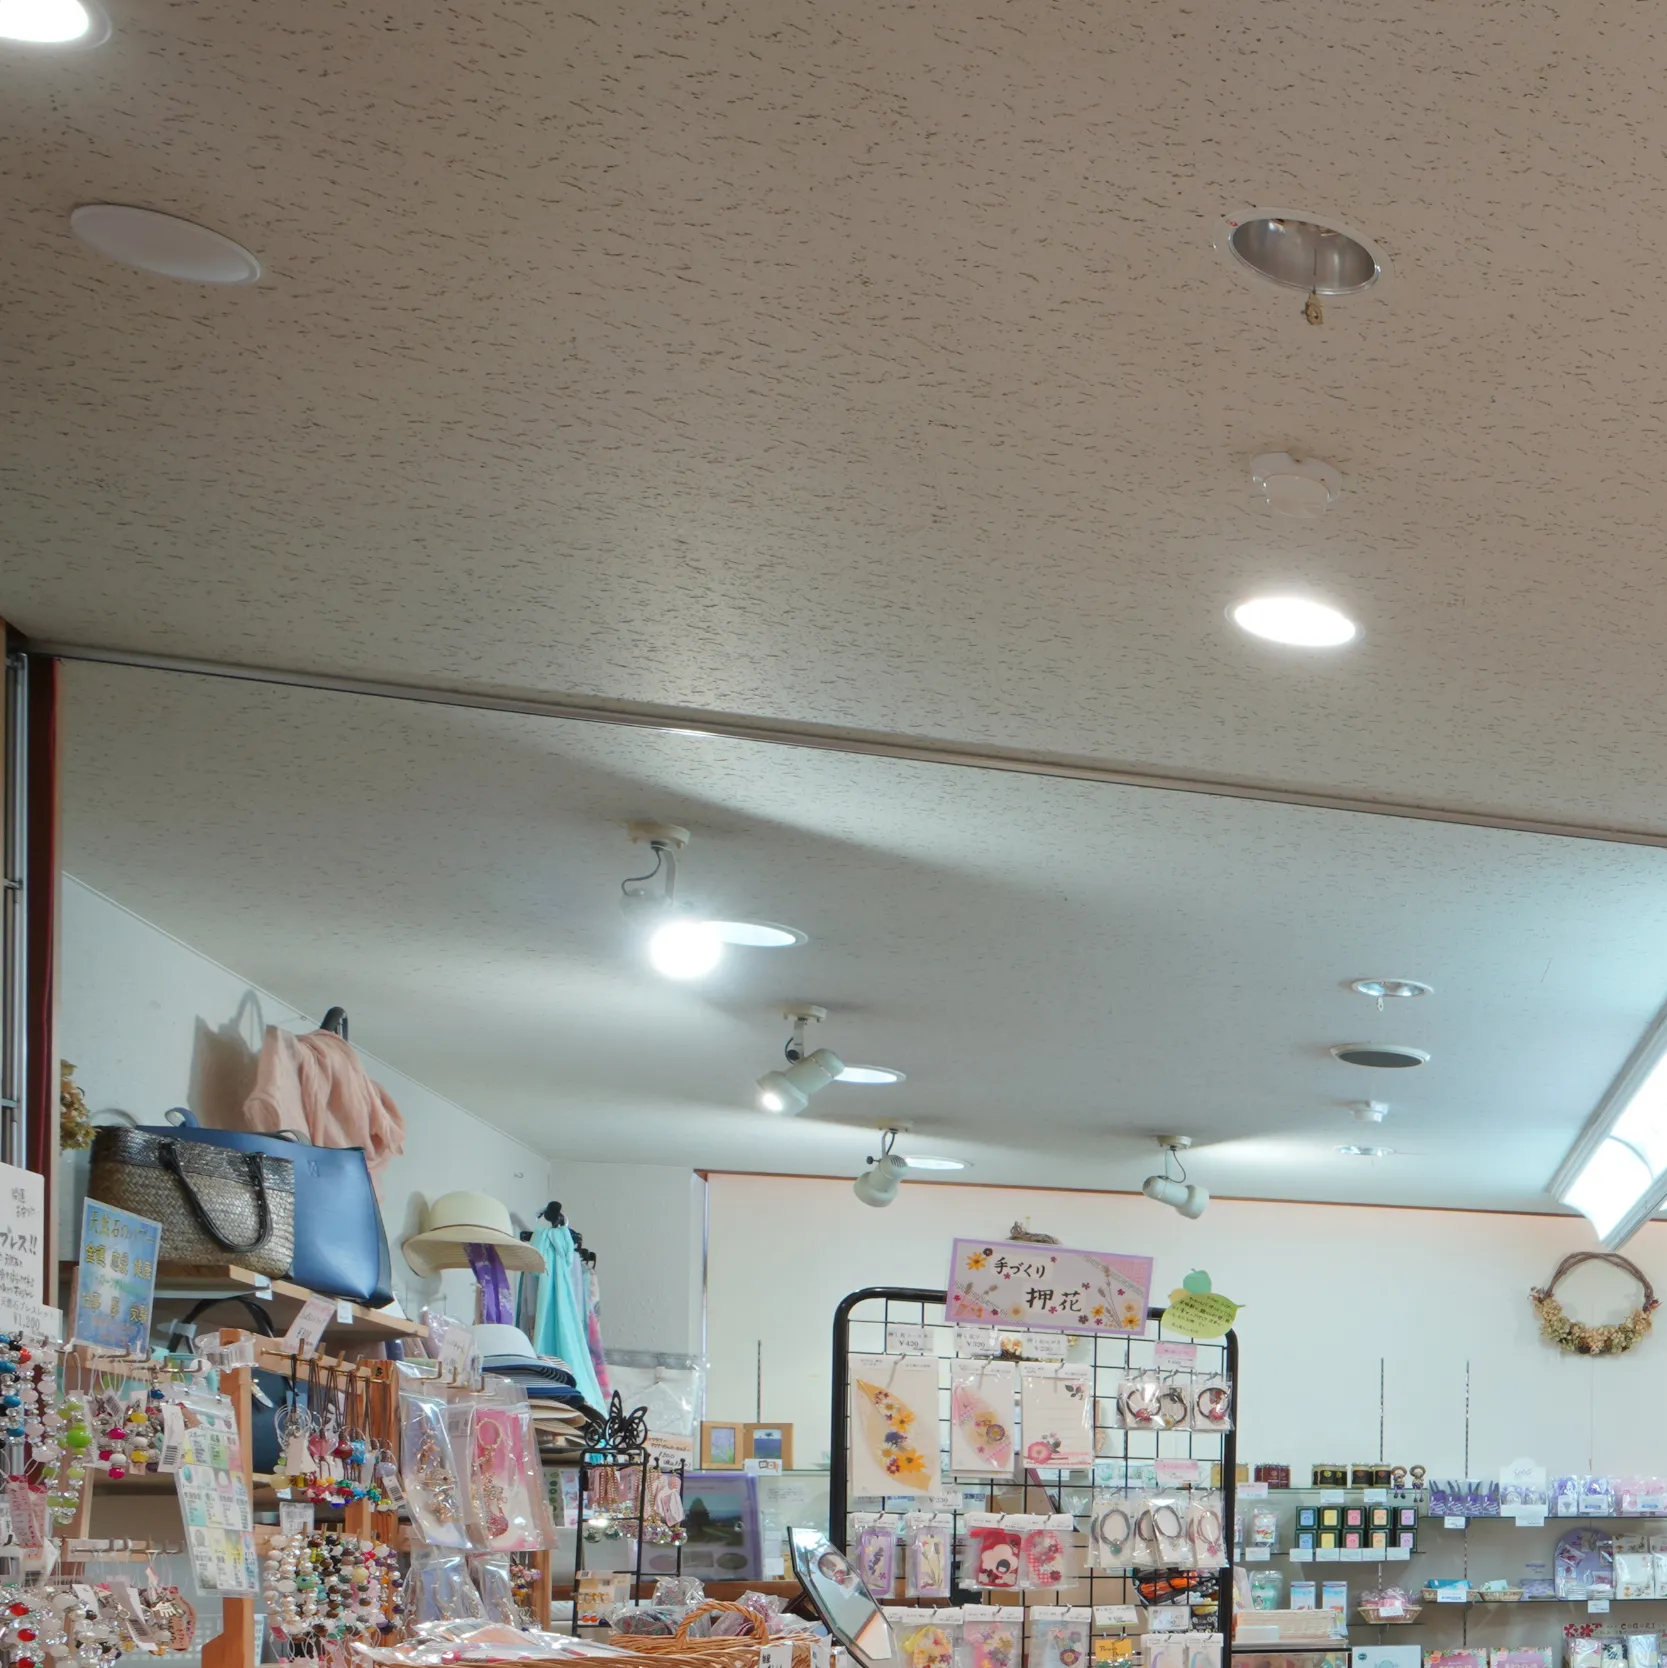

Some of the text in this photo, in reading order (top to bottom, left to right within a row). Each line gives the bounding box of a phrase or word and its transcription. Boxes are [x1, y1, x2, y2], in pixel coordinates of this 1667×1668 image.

[994, 1256, 1047, 1279] 手づくり
[1025, 1287, 1083, 1312] 押花
